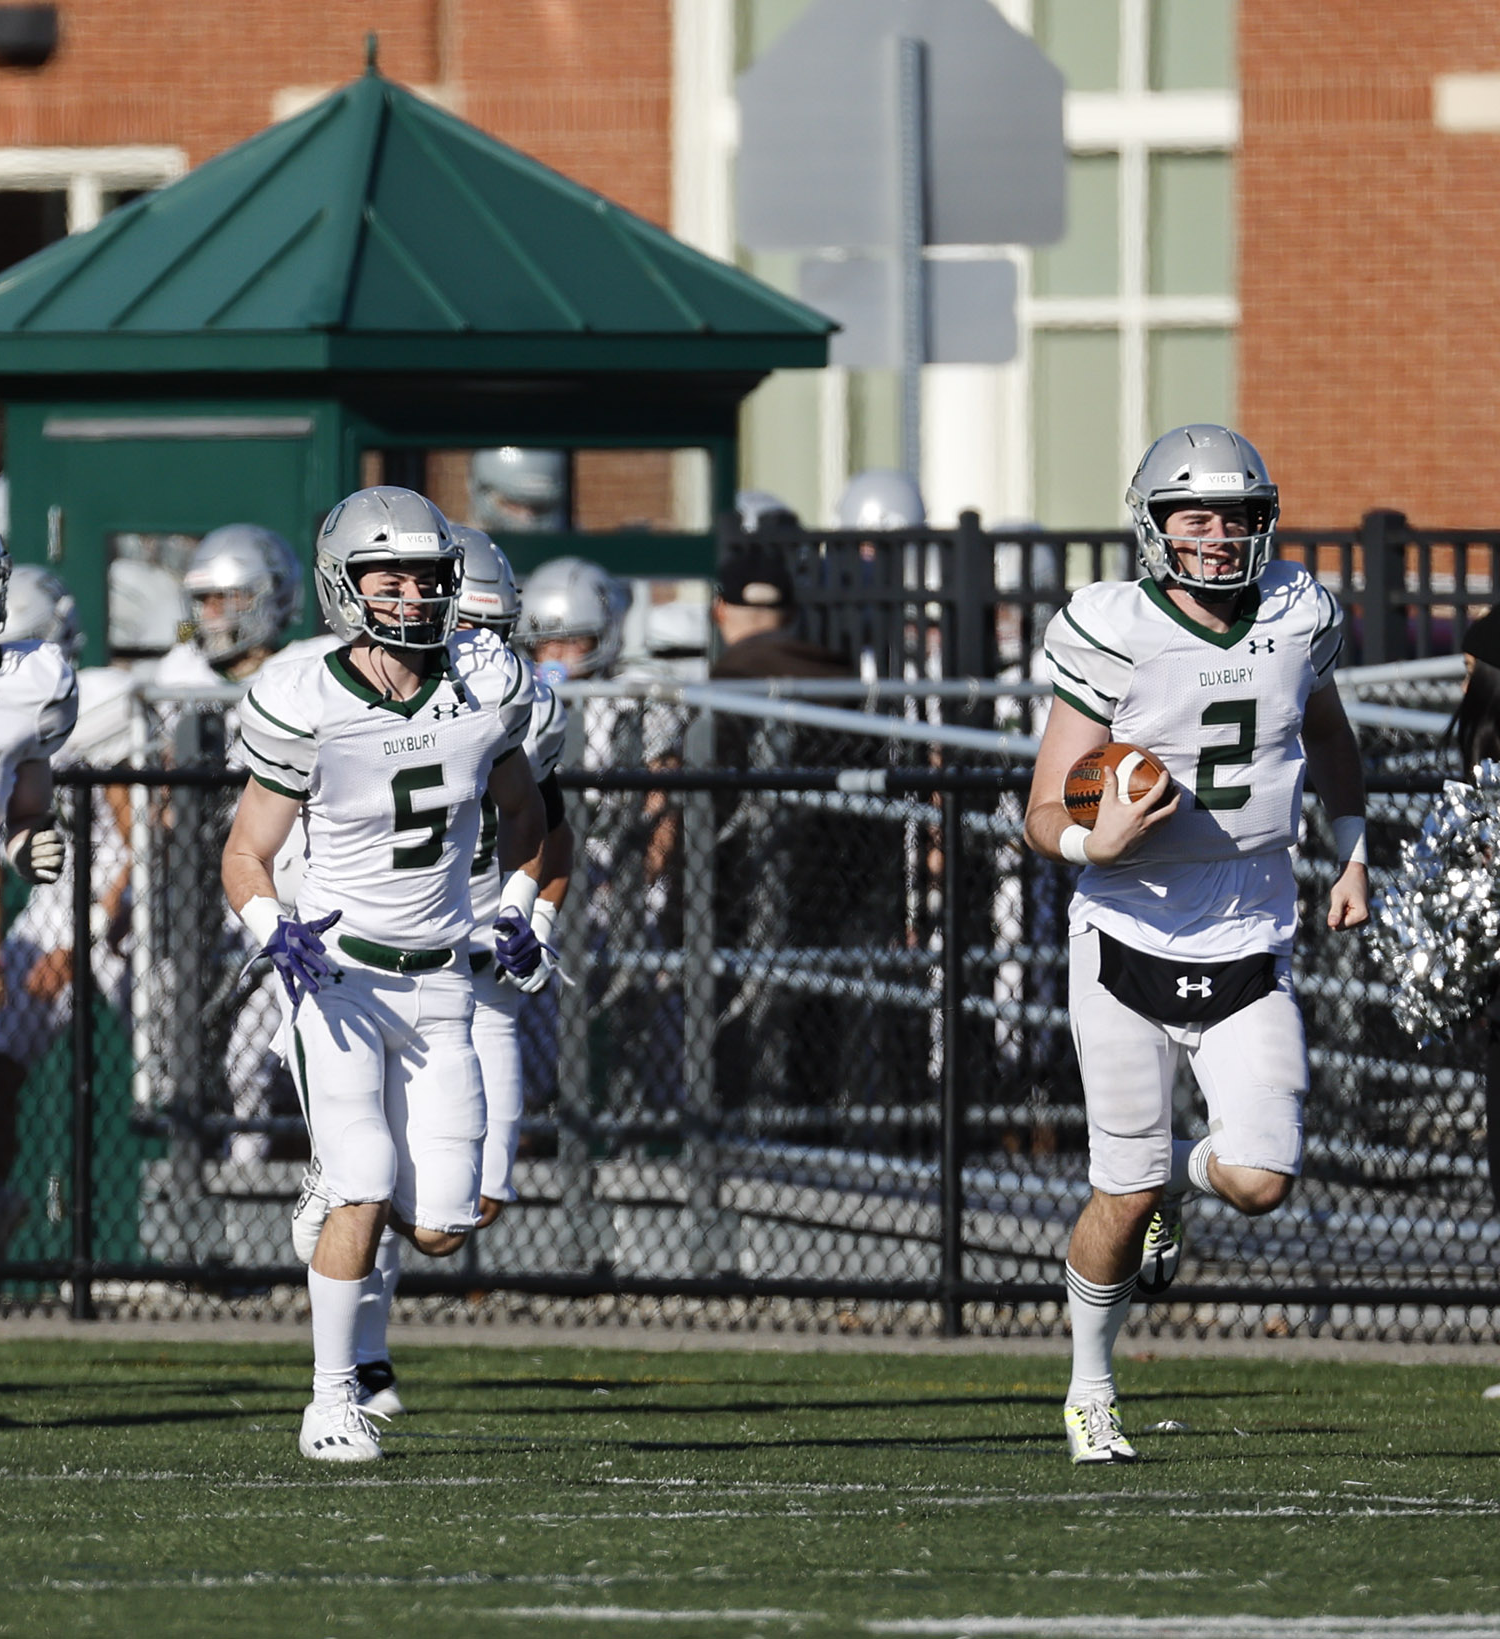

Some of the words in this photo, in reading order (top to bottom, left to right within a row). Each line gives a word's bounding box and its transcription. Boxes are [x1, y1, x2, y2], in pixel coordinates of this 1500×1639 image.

[1208, 474, 1237, 483] VICIS
[406, 536, 433, 544] VICIS
[1199, 667, 1254, 687] DUXBURY
[383, 732, 437, 756] DUXBURY
[1194, 697, 1258, 811] 2
[1070, 768, 1101, 781] Wil
[389, 763, 450, 870] 5
